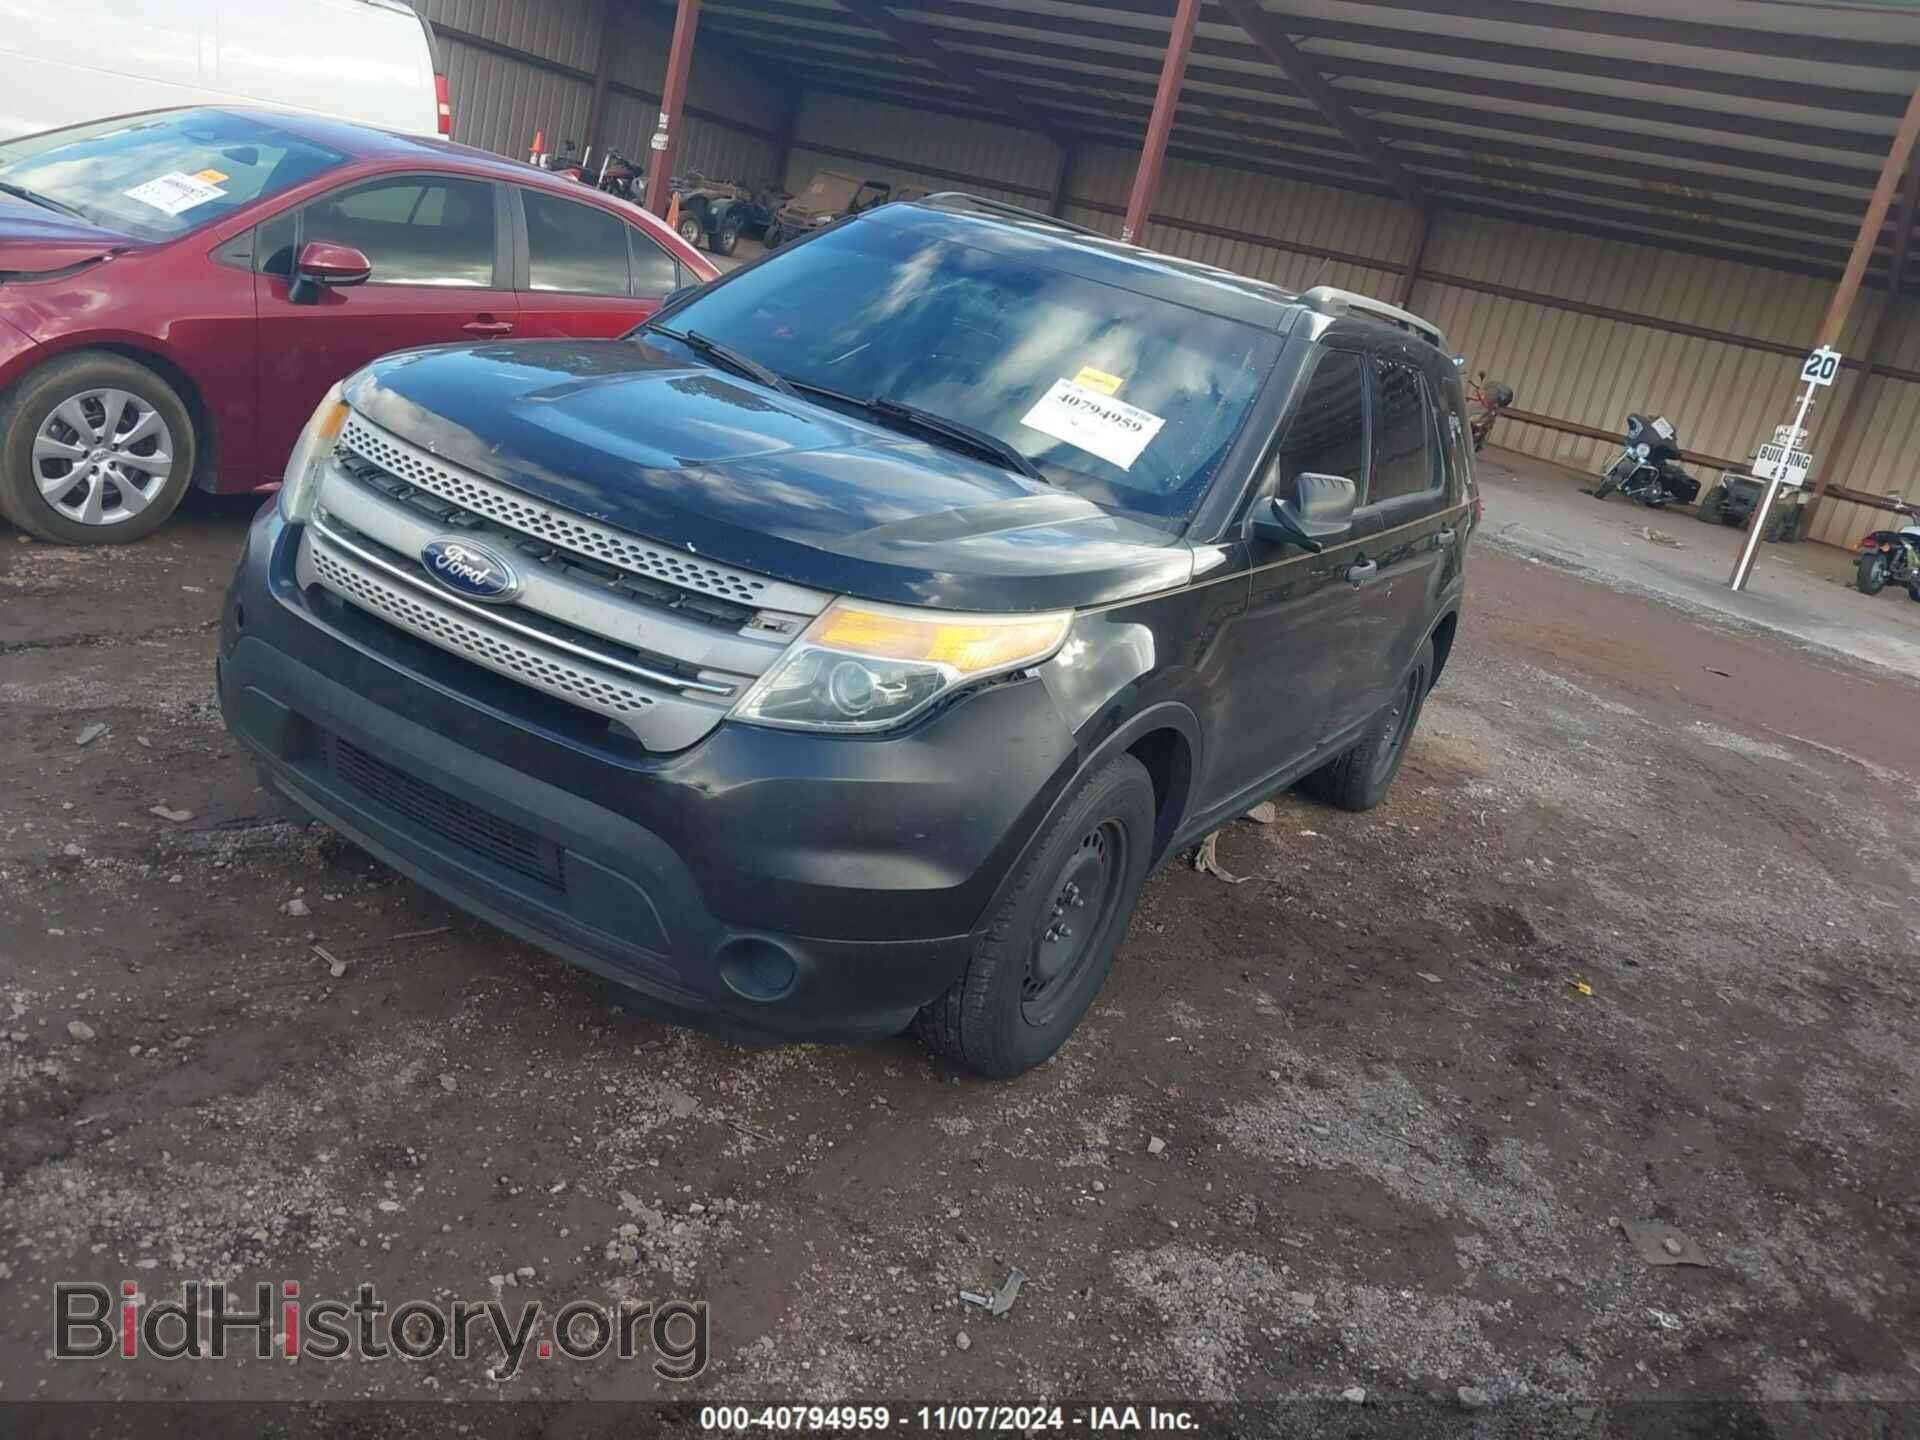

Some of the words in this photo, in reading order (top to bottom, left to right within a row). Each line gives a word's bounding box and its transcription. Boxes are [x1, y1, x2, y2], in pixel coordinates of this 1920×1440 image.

[1804, 353, 1837, 379] 20
[1057, 392, 1144, 433] 40794959
[435, 544, 491, 586] Ford
